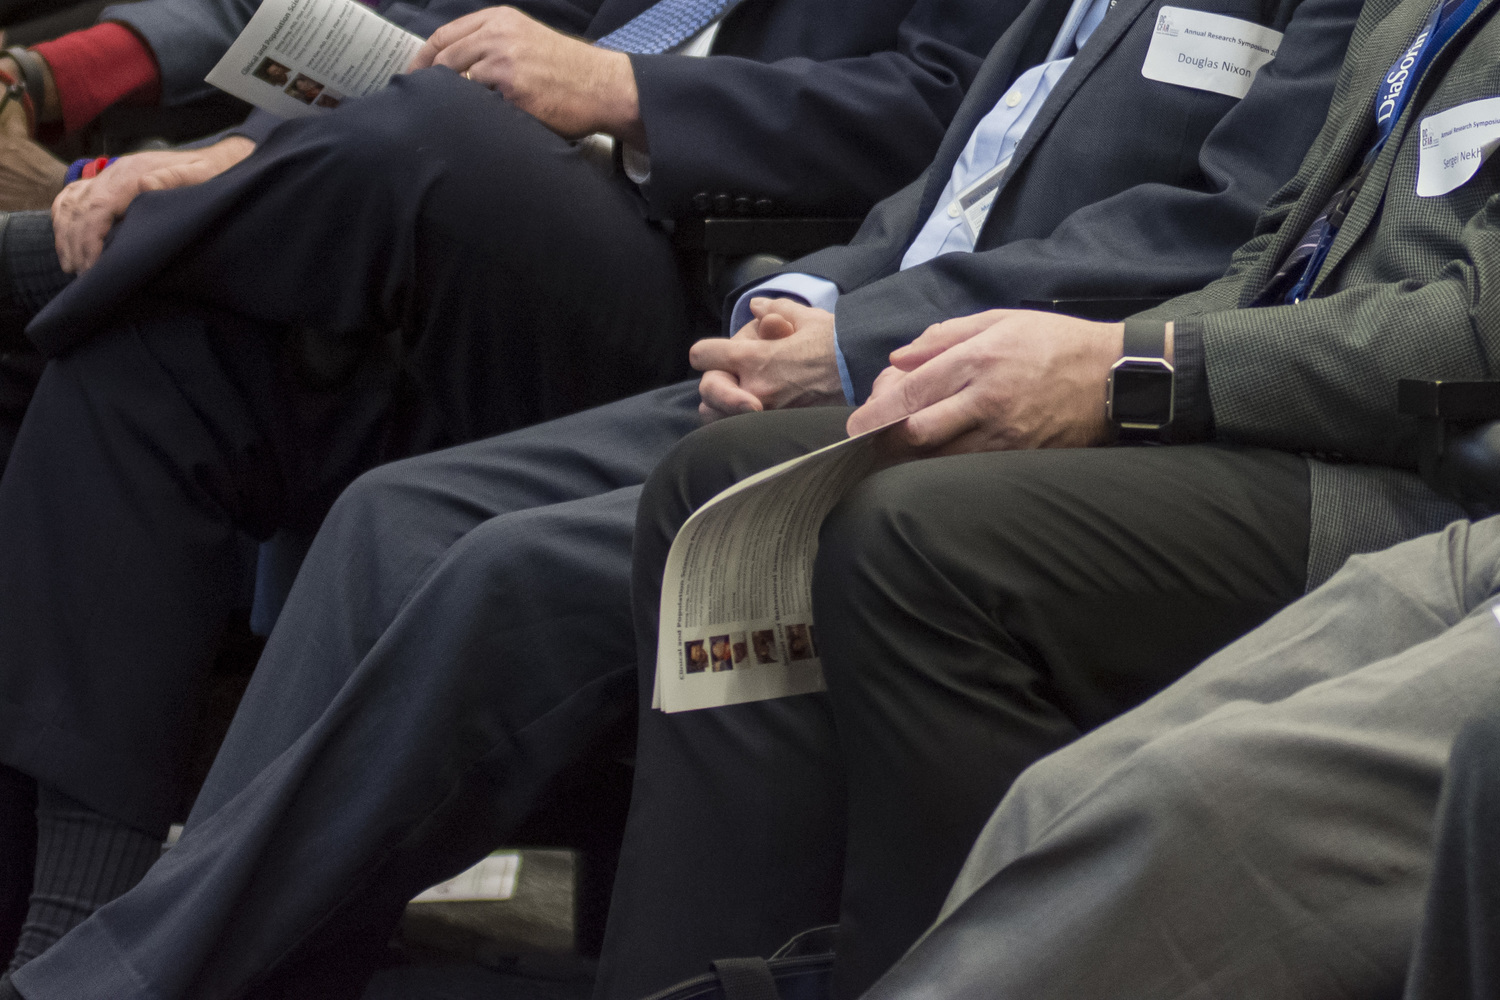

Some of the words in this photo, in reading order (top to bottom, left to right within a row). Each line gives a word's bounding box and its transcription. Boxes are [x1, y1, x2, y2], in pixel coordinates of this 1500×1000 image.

[264, 11, 291, 46] Population
[1184, 28, 1206, 37] Annual
[1207, 32, 1236, 43] Research
[1237, 38, 1270, 54] Symposium
[1178, 53, 1218, 69] Douglas
[1221, 61, 1251, 77] Nixon
[1378, 31, 1429, 124] DiaSorin
[1453, 123, 1472, 133] Research
[1443, 153, 1459, 169] Sergei
[677, 578, 685, 628] Population
